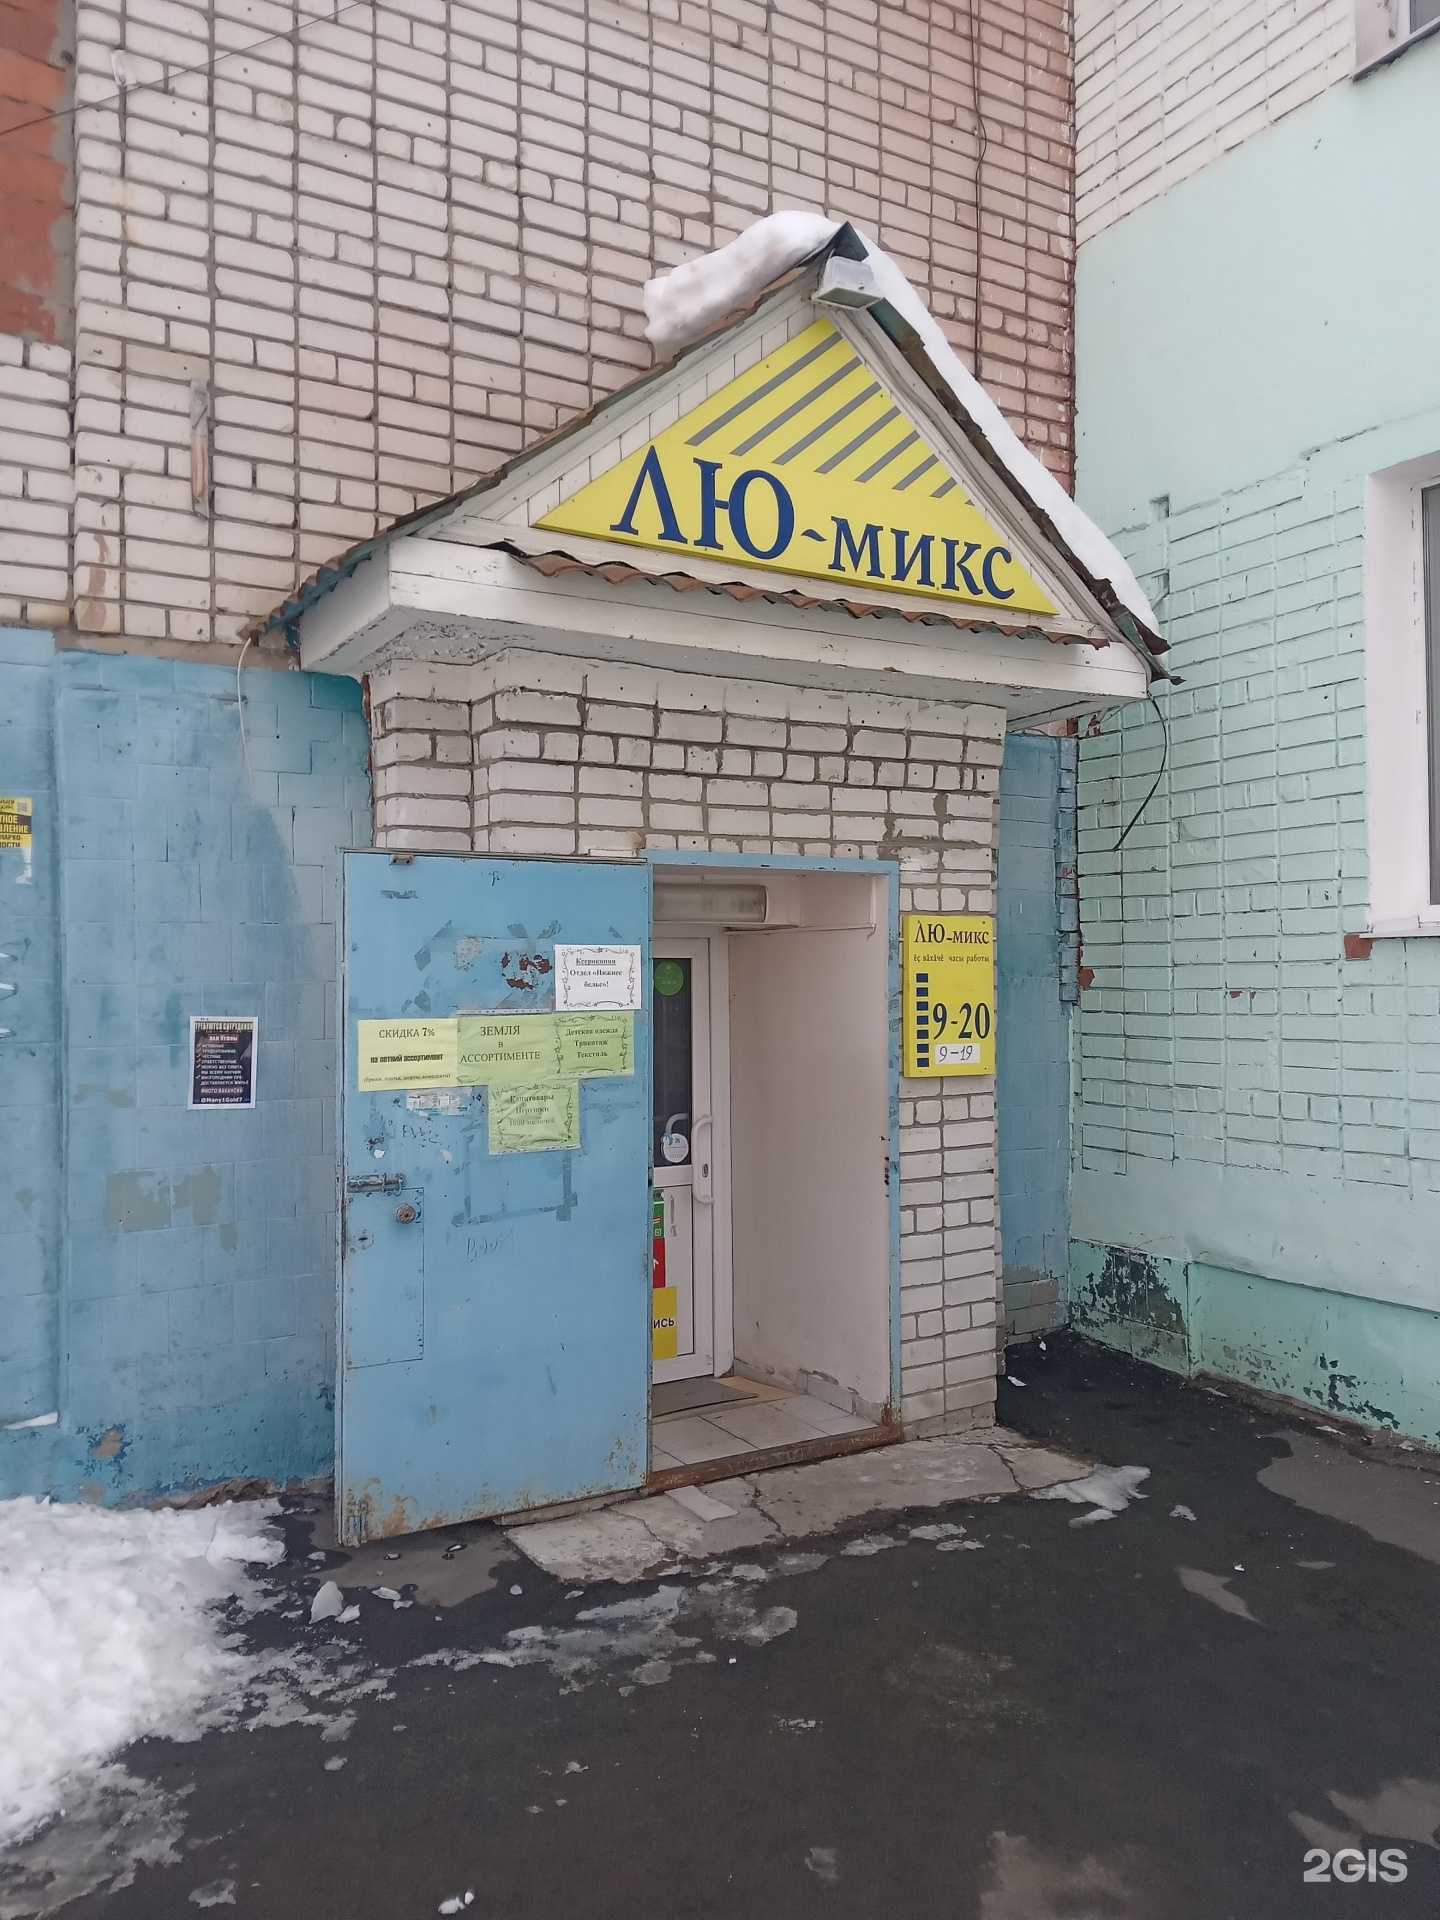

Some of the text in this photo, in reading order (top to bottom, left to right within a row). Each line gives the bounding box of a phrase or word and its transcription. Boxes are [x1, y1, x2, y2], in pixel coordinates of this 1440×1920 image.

[966, 953, 990, 963] работы
[569, 968, 591, 976] Отдел
[379, 1027, 436, 1039] СКИДКА 7%
[480, 1025, 521, 1036] ЗЕМЛЯ
[565, 1028, 593, 1036] Детская
[575, 1039, 609, 1048] Трикотаж
[460, 1050, 541, 1063] АССОРТИМЕНТЕ
[577, 1051, 608, 1059] Текстиль
